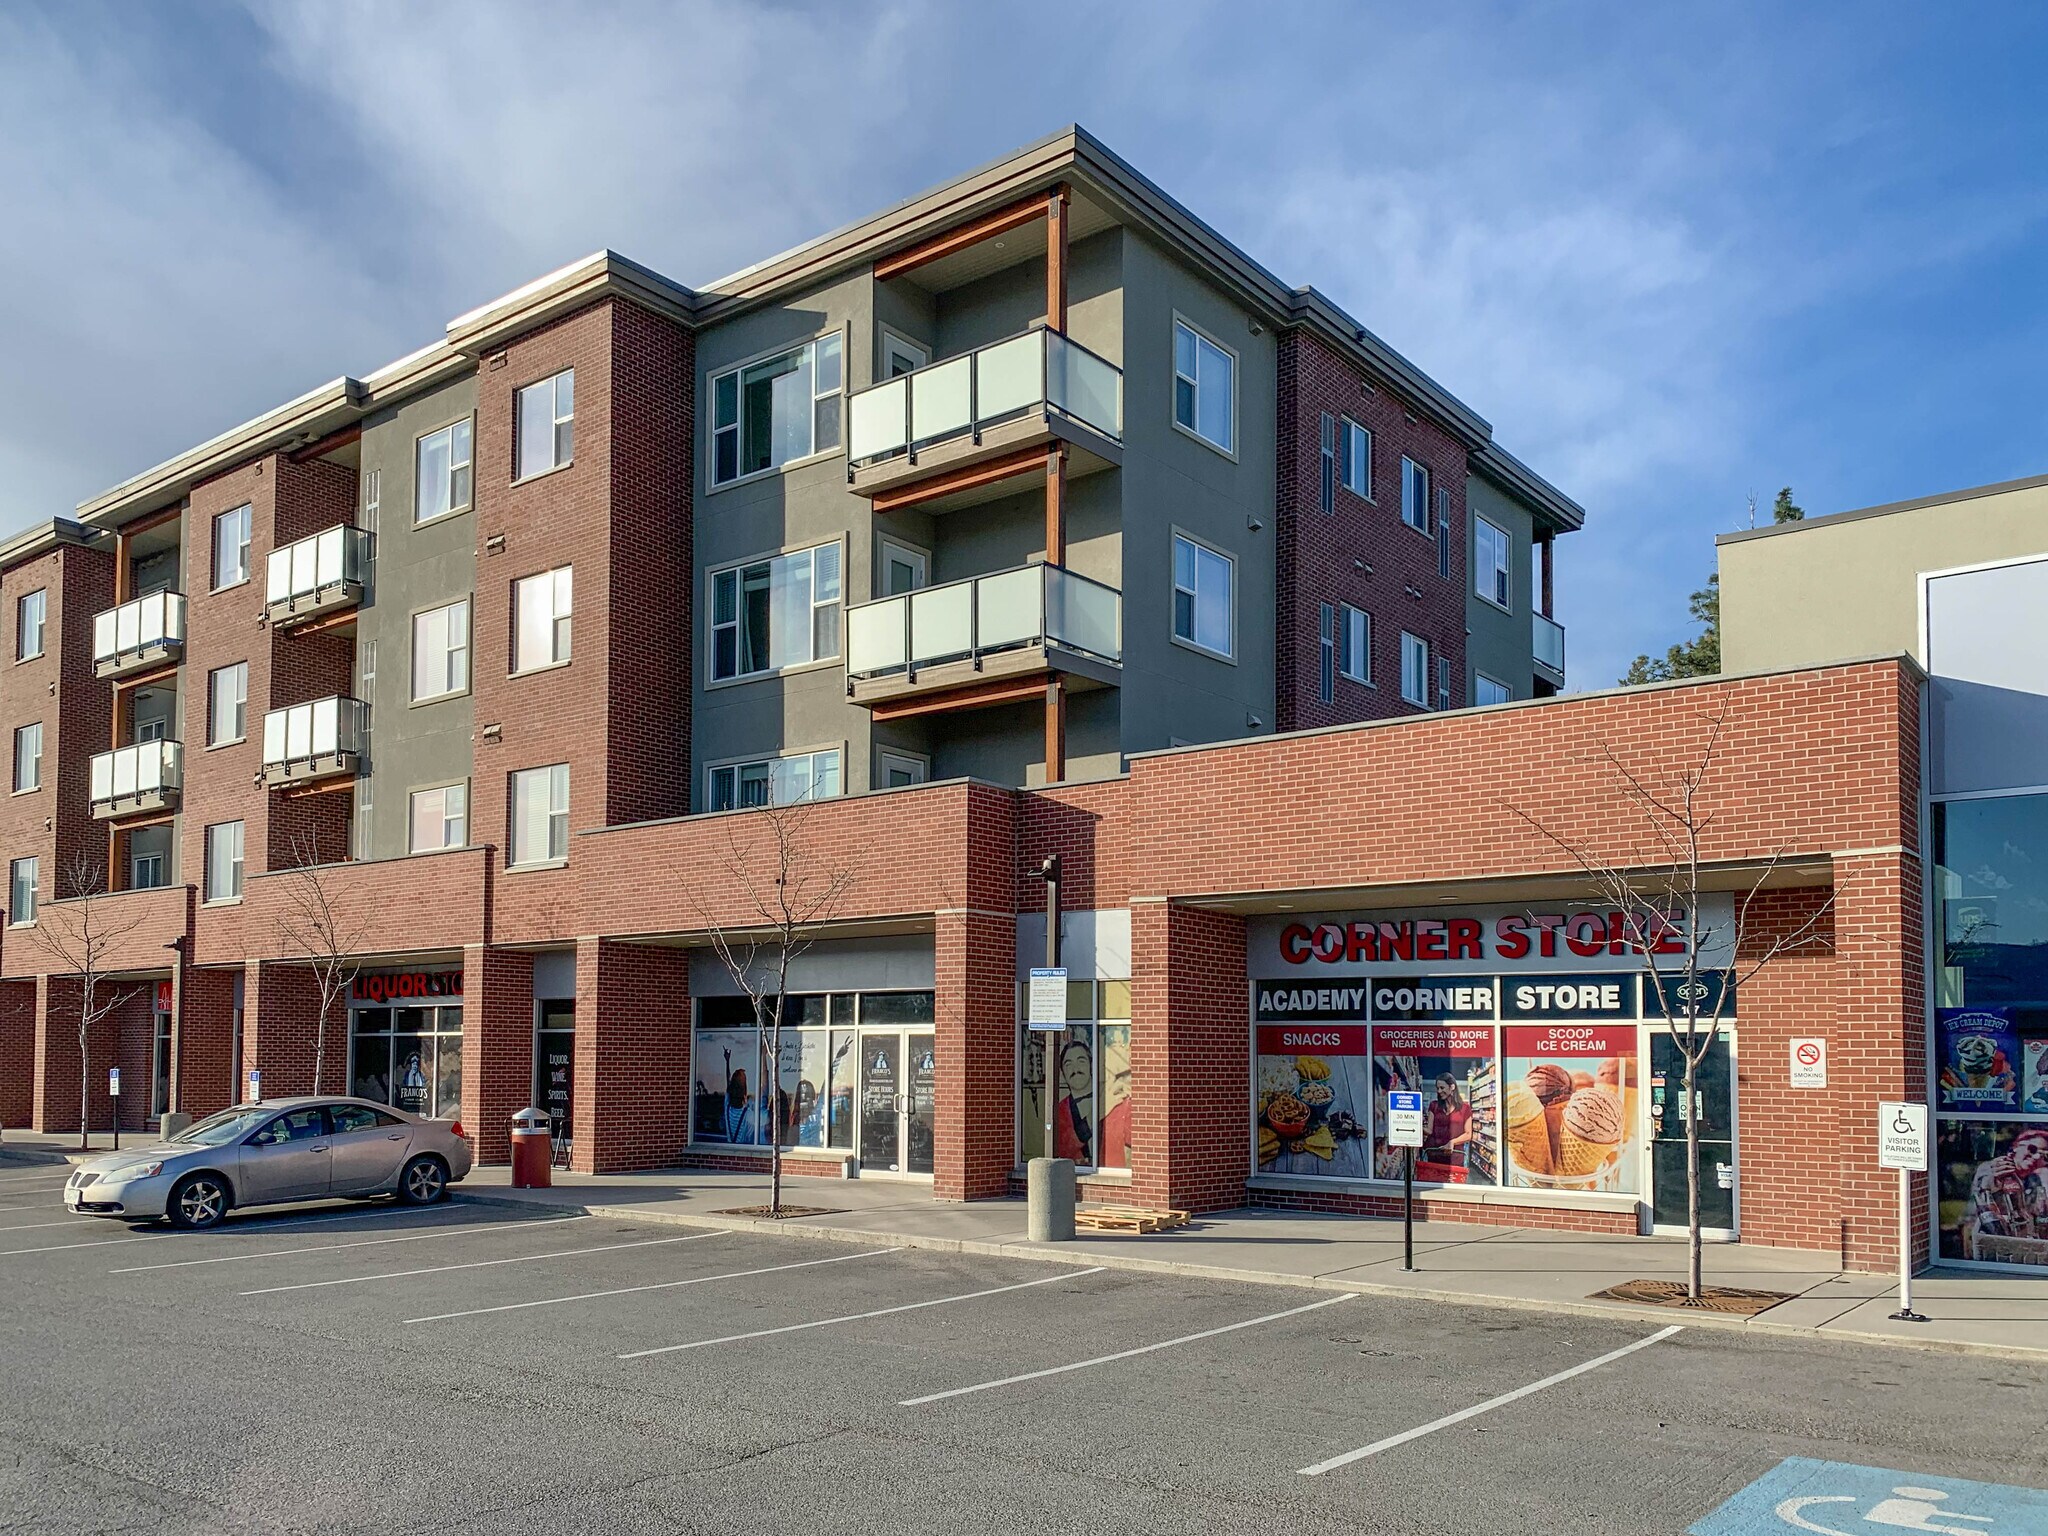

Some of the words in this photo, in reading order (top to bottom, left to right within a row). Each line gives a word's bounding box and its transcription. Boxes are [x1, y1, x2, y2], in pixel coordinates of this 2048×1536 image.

[1280, 918, 1484, 965] CORNER
[1496, 909, 1686, 959] STORE
[352, 973, 428, 1003] LIQUOR
[432, 969, 464, 997] STO
[1259, 988, 1365, 1011] ACADEMY
[1375, 987, 1492, 1011] CORNER
[1516, 985, 1620, 1010] STORE
[1283, 1033, 1341, 1046] SNACKS
[1380, 1030, 1434, 1039] GROCERIES
[1437, 1030, 1457, 1039] AND
[1460, 1030, 1489, 1039] MORE
[1548, 1028, 1594, 1040] SCOOP
[1391, 1040, 1417, 1048] NEAR
[1419, 1040, 1445, 1048] YOUR
[1448, 1040, 1477, 1049] DOOR
[1536, 1040, 1557, 1051] ICE
[1560, 1040, 1606, 1051] CREAM
[400, 1087, 428, 1099] FRANCO'S
[1955, 1090, 2003, 1099] WELCOME
[1680, 1104, 1701, 1112] ON
[1887, 1137, 1919, 1145] VISITOR
[1885, 1145, 1921, 1153] PARKING
